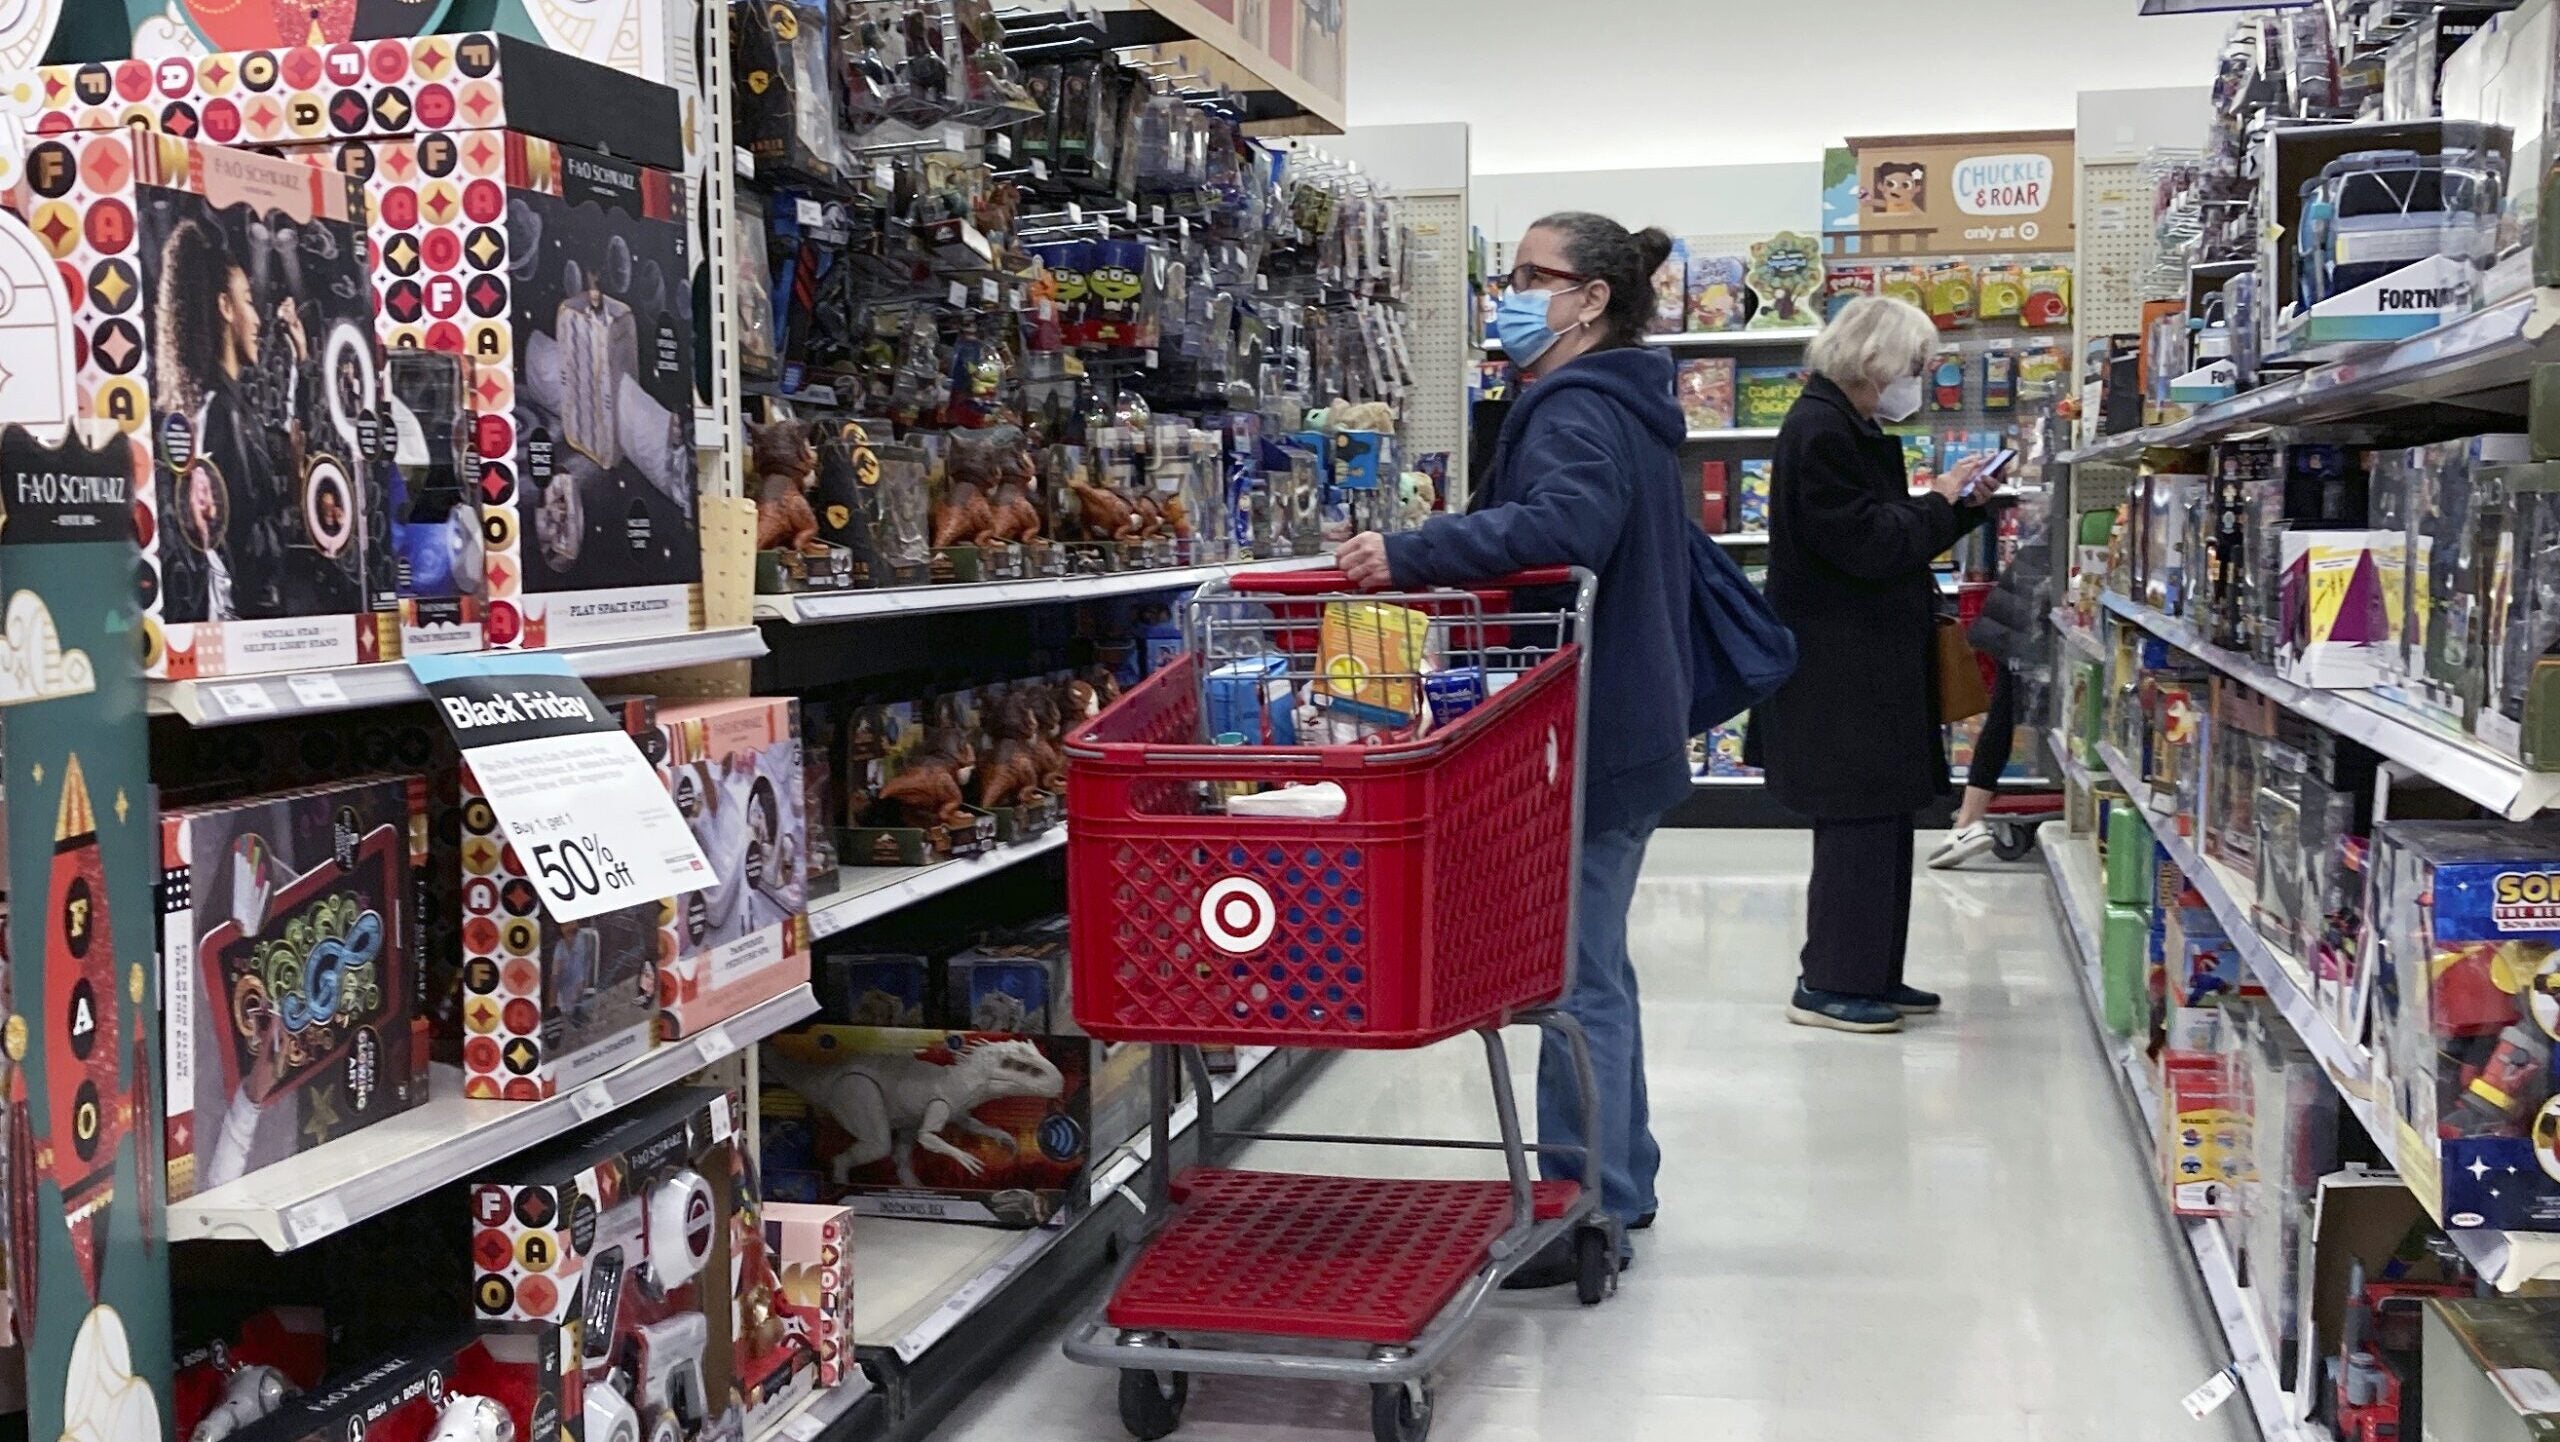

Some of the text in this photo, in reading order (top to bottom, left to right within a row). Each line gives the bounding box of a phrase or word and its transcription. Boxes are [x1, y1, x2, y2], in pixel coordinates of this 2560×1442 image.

[39, 152, 64, 189] F
[426, 141, 448, 171] F
[1958, 161, 2045, 198] CHUCKLE
[1975, 182, 2040, 208] & ROAR
[1964, 225, 2015, 241] only at
[432, 282, 453, 312] F
[477, 328, 499, 354] A
[109, 387, 134, 421] A
[59, 473, 126, 504] SCHWARZ
[441, 691, 596, 729] Black Friday
[511, 821, 535, 835] Buy
[547, 815, 565, 831] get
[532, 833, 614, 902] 50%
[605, 861, 636, 890] off
[470, 884, 492, 909] A
[471, 963, 491, 987] F
[73, 998, 95, 1036] A
[348, 1057, 357, 1090] ART
[357, 1030, 368, 1111] GLOWING
[77, 1101, 97, 1140] O
[481, 1192, 501, 1220] F
[525, 1237, 547, 1264] A
[367, 1401, 388, 1422] BISH
[403, 1379, 425, 1401] BOSH
